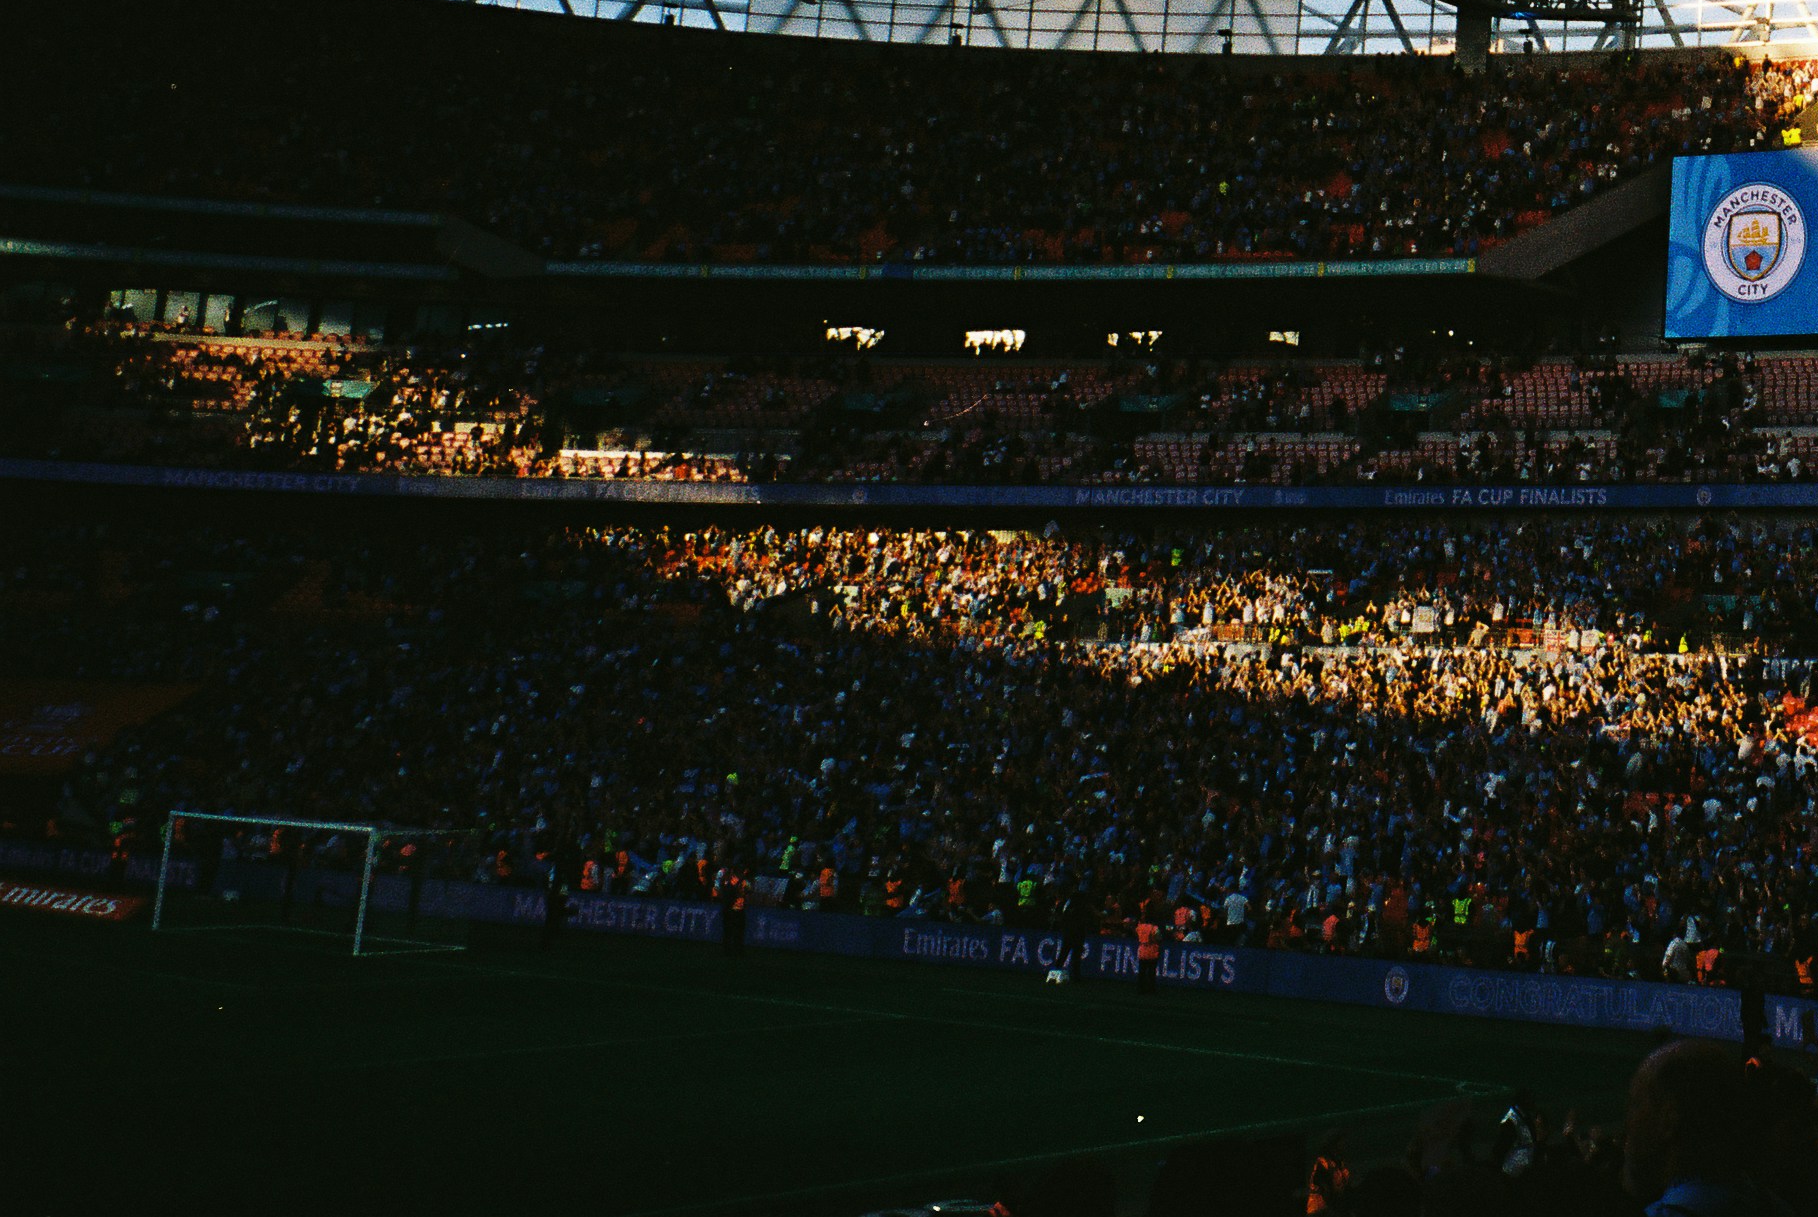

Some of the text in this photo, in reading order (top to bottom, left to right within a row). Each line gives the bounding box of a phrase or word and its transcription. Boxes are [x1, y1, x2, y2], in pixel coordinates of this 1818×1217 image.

[1713, 189, 1798, 228] MANCHESTER
[1737, 283, 1768, 296] CITY
[313, 475, 361, 492] CITY
[595, 484, 618, 500] FA
[1075, 488, 1197, 505] MANCHESTER
[1202, 488, 1244, 506] CITY
[1384, 488, 1608, 506] Emirates FA CUP FINALISTS
[0, 887, 117, 916] mirates
[512, 893, 659, 930] MACHESTER
[664, 905, 720, 934] CITY
[902, 927, 989, 960] Emirates
[1000, 934, 1029, 965] FA
[1100, 941, 1237, 985] FINLISTS
[1450, 974, 1745, 1039] CONGRATULATION
